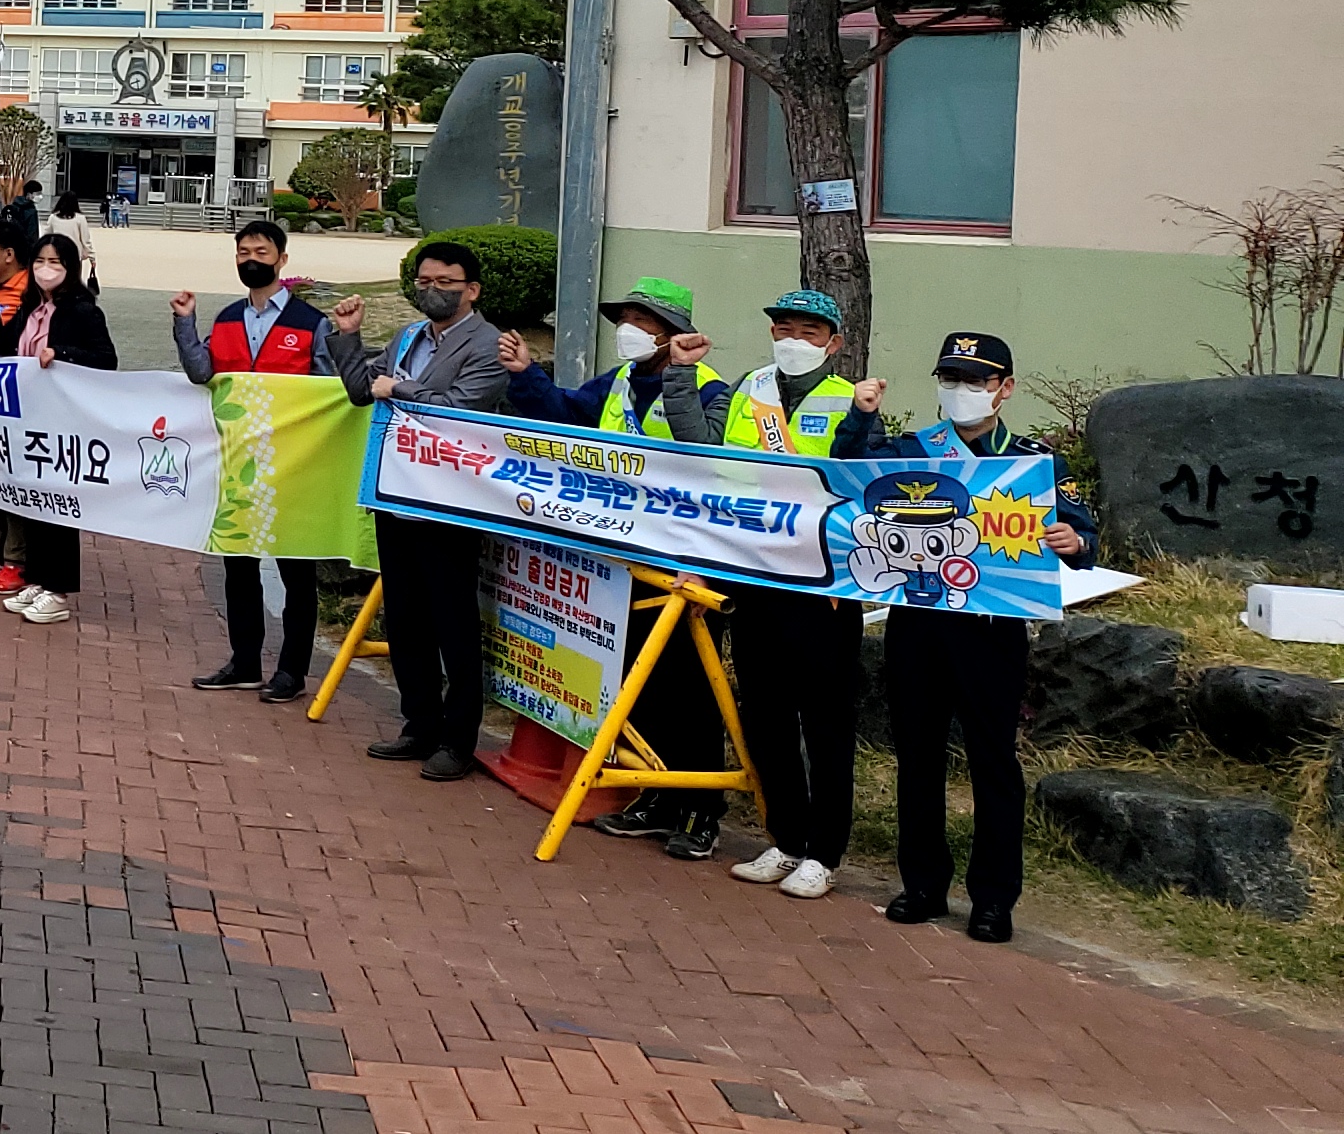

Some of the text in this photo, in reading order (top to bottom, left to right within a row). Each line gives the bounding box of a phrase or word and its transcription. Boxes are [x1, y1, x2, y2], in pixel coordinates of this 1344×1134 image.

[64, 110, 211, 129] 높고 푸른 꿈을 우리 가슴에
[24, 430, 110, 485] 주세요
[503, 432, 645, 476] 학교폭력 신고 117
[490, 457, 554, 493] 없는
[559, 467, 640, 512] 행복한
[642, 485, 702, 520] 산청
[701, 493, 803, 537] 만들기
[540, 501, 636, 536] 산청경찰서
[1160, 464, 1319, 538] 산청
[982, 512, 1037, 542] NO!
[527, 555, 590, 604] 출입금지
